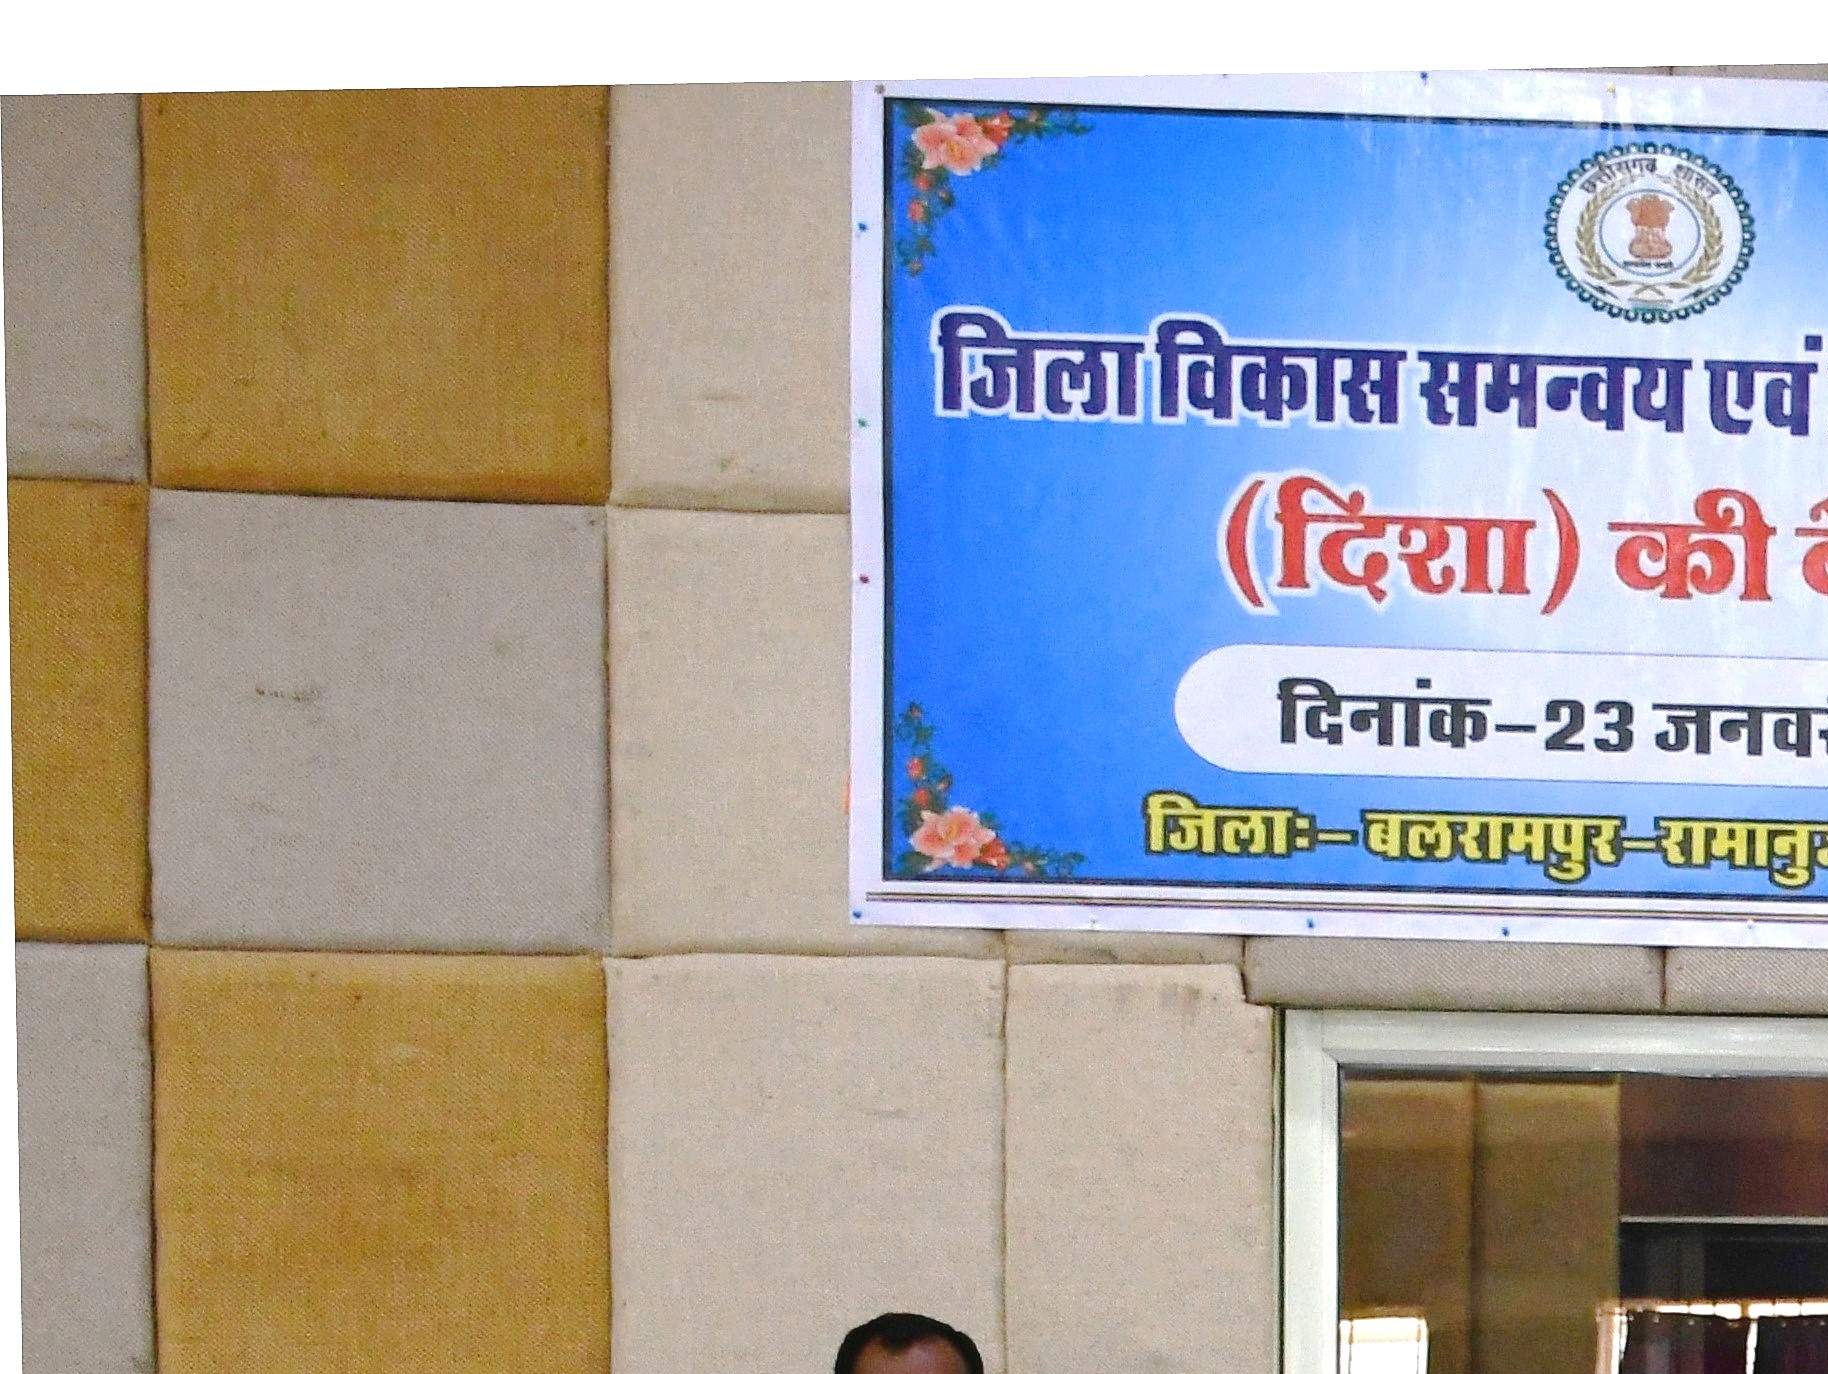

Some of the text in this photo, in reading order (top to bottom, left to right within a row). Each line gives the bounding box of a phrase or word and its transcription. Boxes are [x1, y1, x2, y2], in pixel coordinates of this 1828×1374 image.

[937, 312, 1145, 417] जिला
[1155, 318, 1408, 425] विकास
[1418, 348, 1691, 433] समन्वय
[1704, 335, 1823, 436] एवं
[1225, 475, 1581, 615] (दिशा)
[1607, 488, 1777, 602] की
